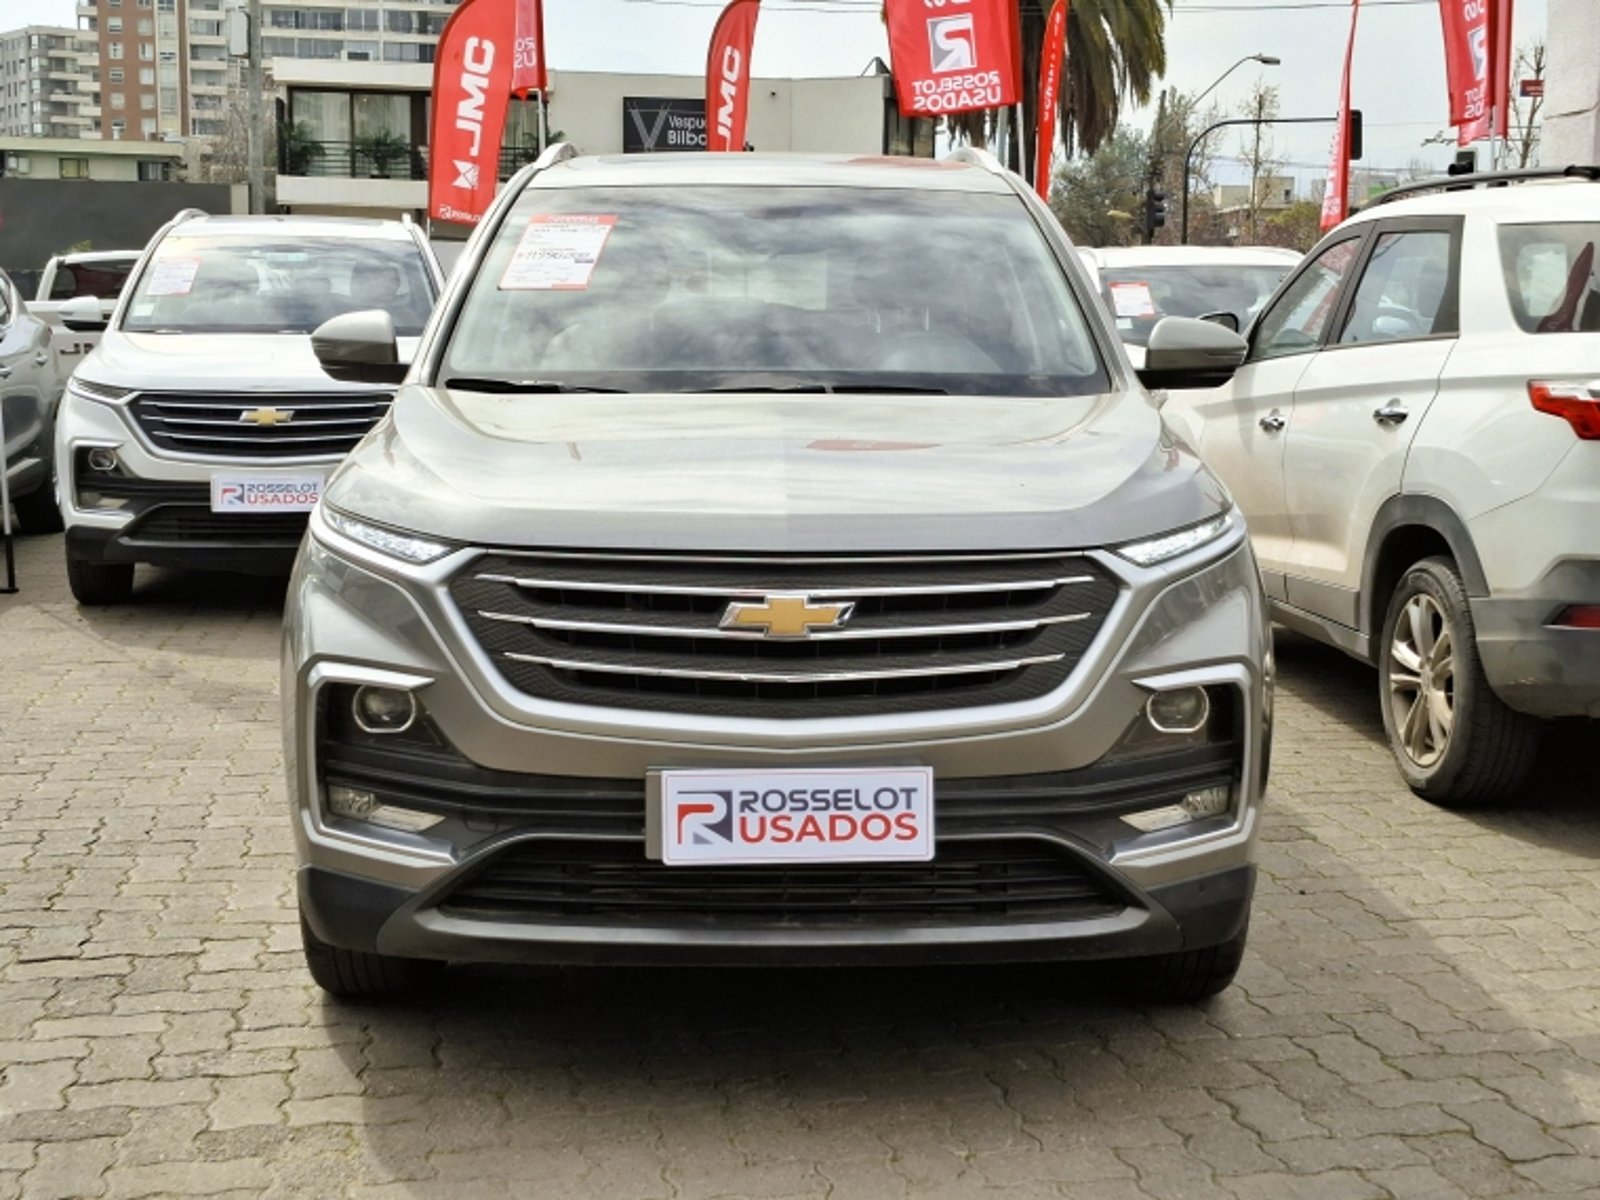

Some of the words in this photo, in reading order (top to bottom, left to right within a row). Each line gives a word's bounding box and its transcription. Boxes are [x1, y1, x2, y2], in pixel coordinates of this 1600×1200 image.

[455, 36, 496, 157] JMC
[668, 115, 706, 131] Vespu
[247, 483, 319, 493] ROSSELOT
[247, 493, 319, 504] USADOS
[739, 787, 918, 813] ROSSELOT
[739, 812, 919, 843] USADOS
